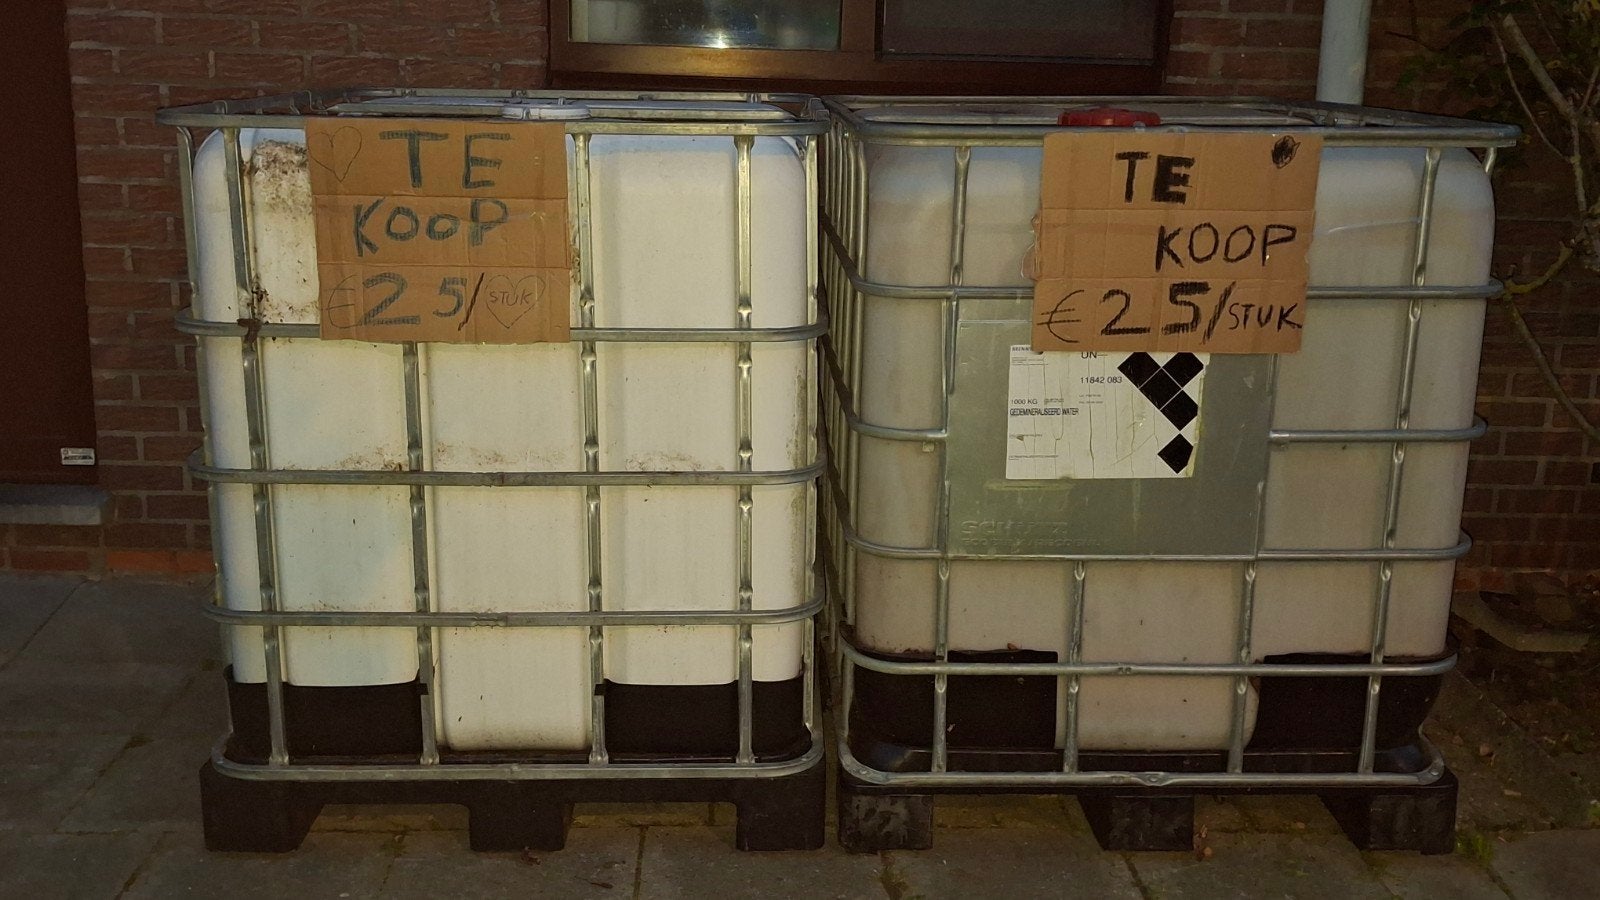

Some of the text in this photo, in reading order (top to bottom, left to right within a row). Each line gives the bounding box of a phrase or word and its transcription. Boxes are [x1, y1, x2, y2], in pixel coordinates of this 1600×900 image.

[379, 128, 514, 189] TE
[1115, 151, 1196, 204] TE
[353, 196, 508, 257] KOOP
[1155, 222, 1297, 273] KOOP
[1080, 376, 1123, 384] 11842 083
